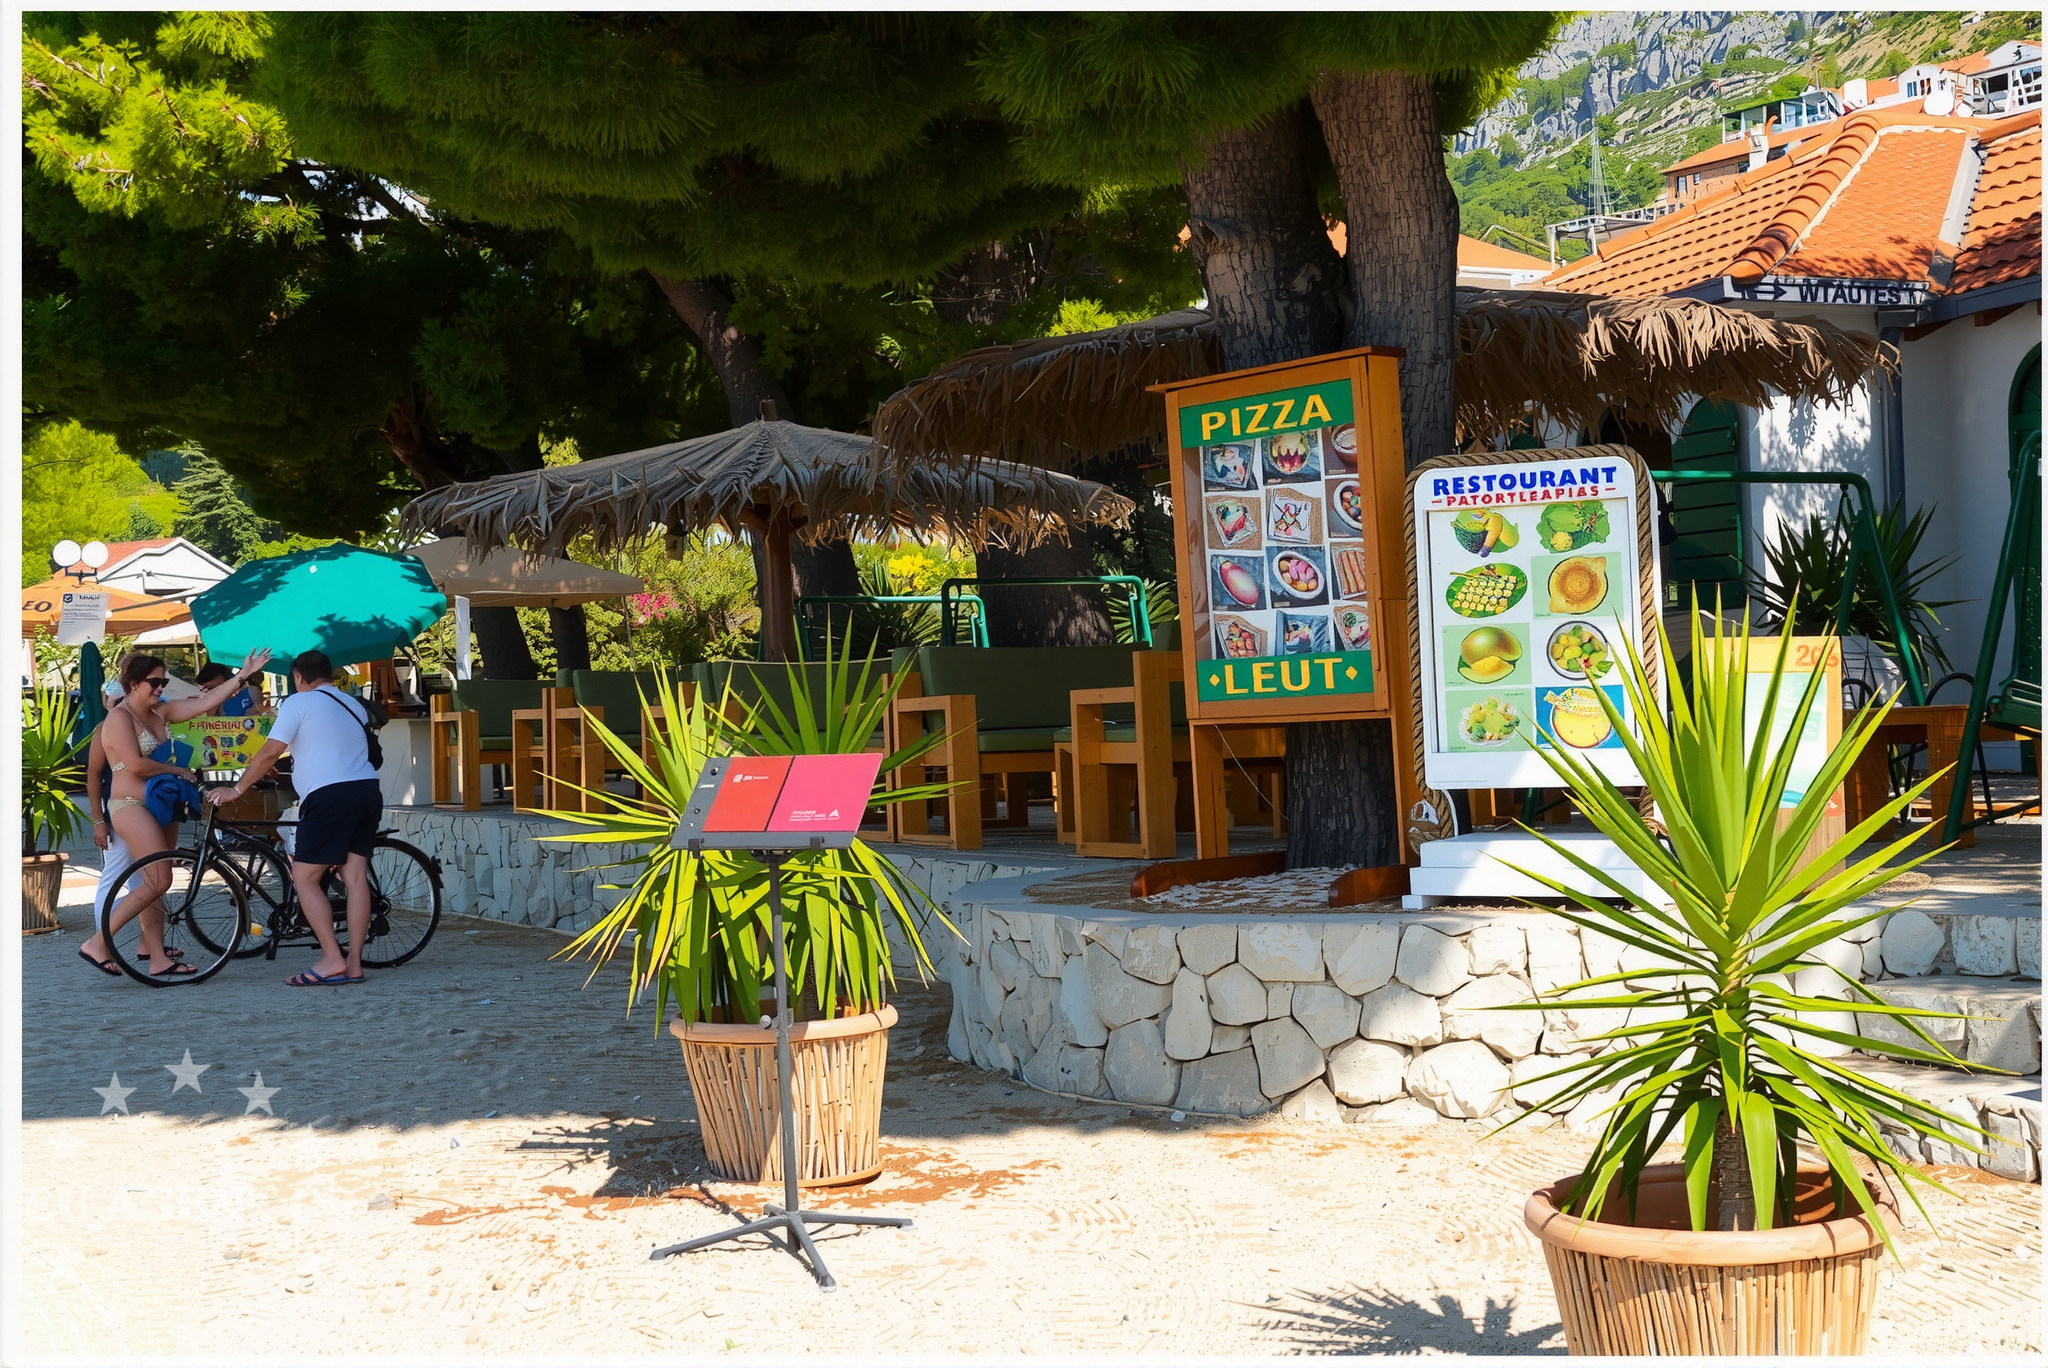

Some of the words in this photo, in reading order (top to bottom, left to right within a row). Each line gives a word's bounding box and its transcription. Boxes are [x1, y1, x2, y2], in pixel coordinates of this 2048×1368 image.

[1201, 393, 1333, 441] PIZZA
[1433, 466, 1617, 497] RESTOURANT
[1224, 657, 1343, 695] LEUT
